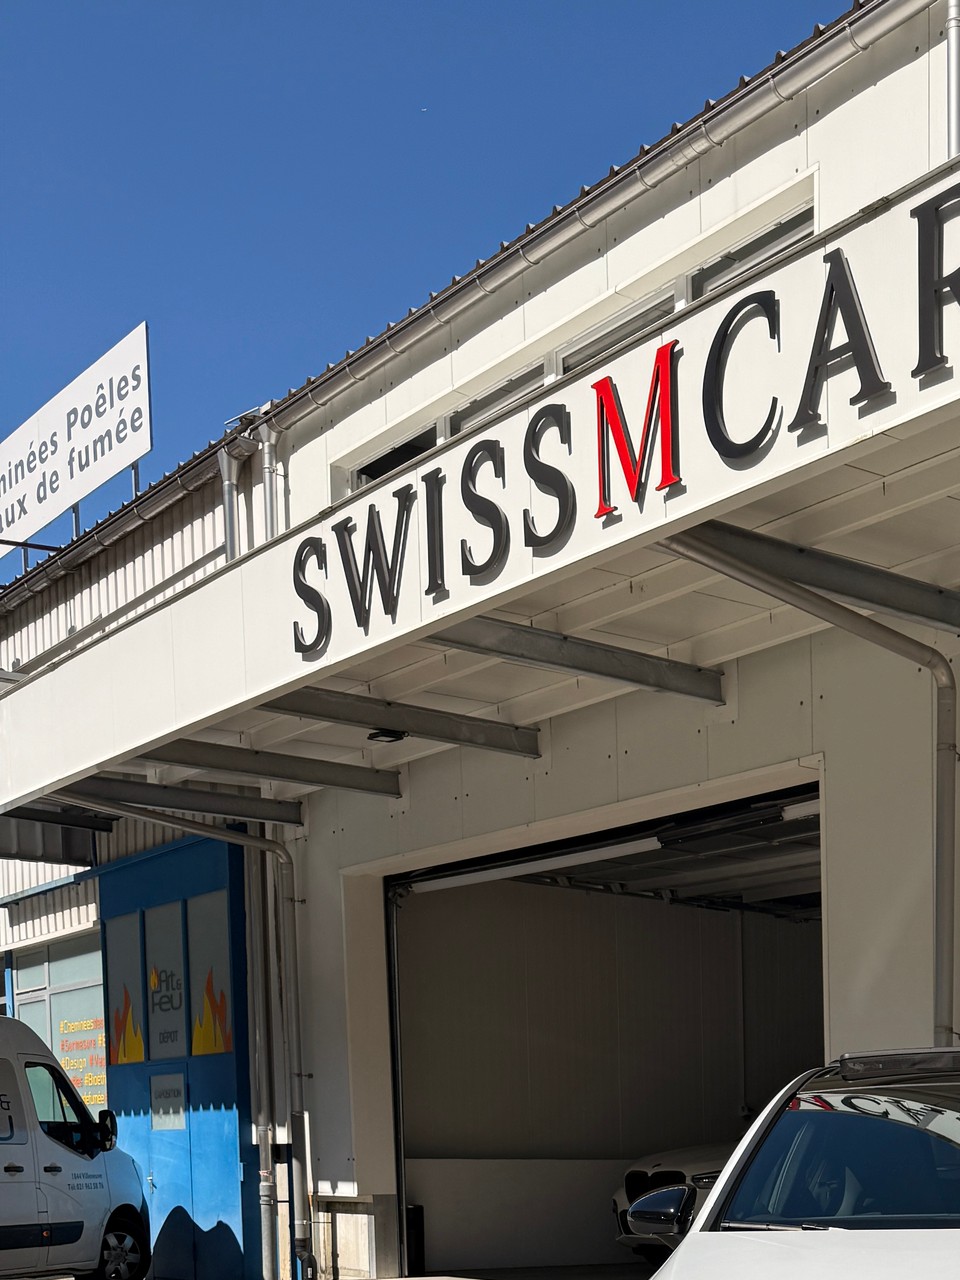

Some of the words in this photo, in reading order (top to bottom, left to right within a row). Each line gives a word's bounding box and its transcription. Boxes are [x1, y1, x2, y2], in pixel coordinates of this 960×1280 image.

[66, 364, 142, 442] Poêles
[36, 470, 59, 504] de
[67, 406, 143, 480] fumée
